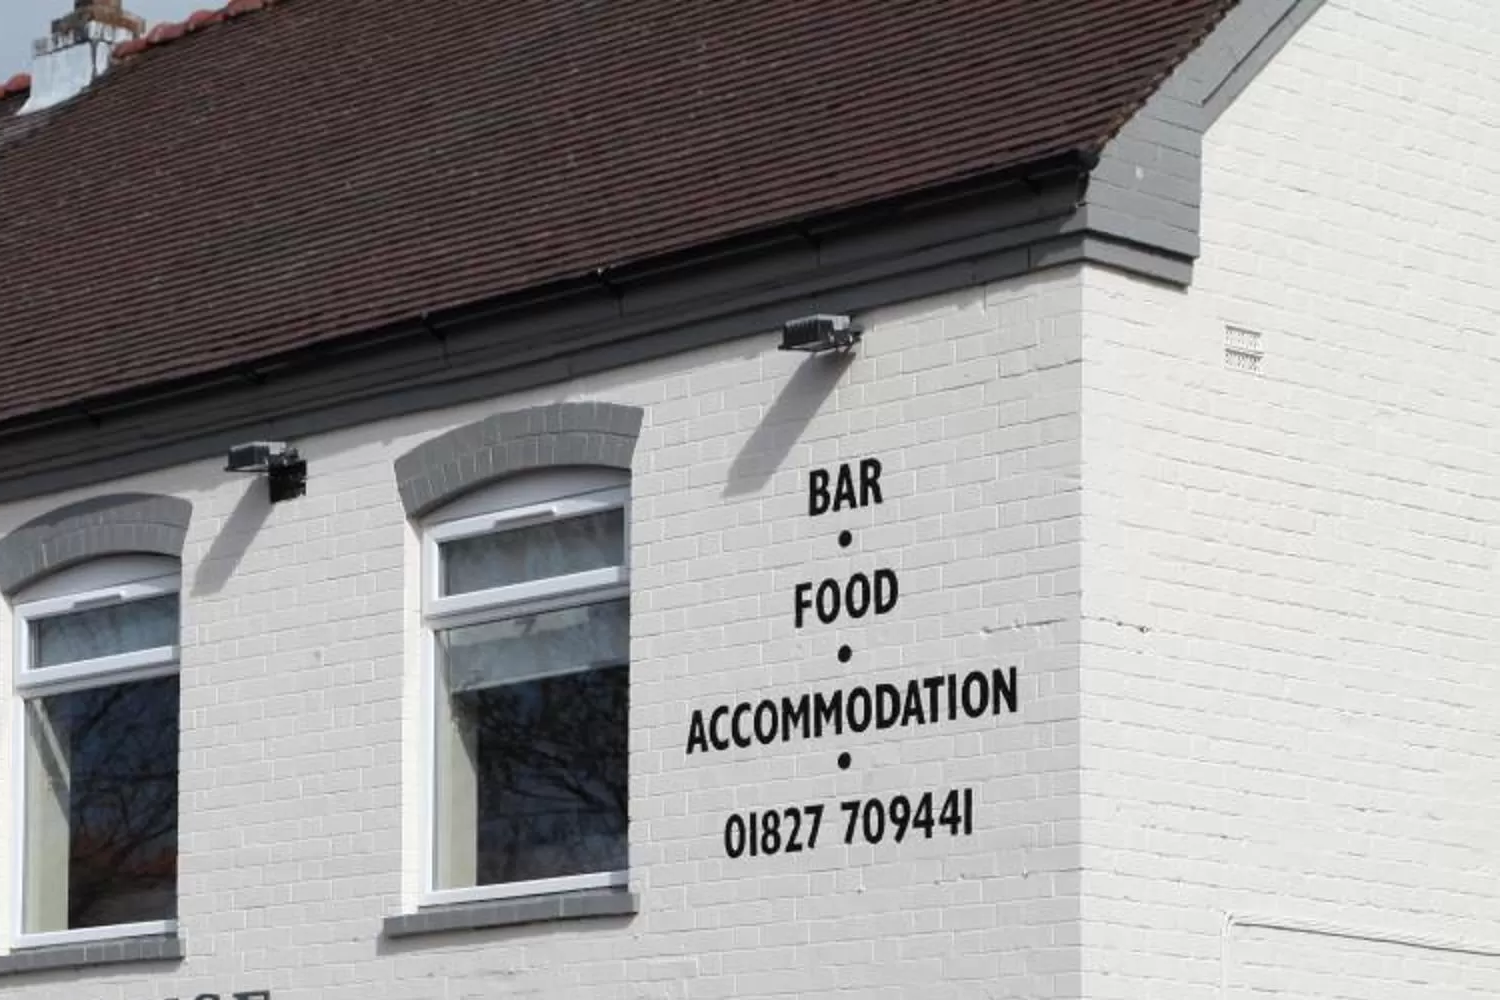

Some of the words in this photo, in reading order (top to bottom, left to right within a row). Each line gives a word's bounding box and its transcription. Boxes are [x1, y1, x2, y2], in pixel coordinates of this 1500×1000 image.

[808, 457, 883, 517] BAR
[794, 568, 899, 629] FOOD
[686, 665, 1018, 755] ACCOMMODATION
[724, 803, 825, 859] 01827
[840, 787, 973, 845] 709441
